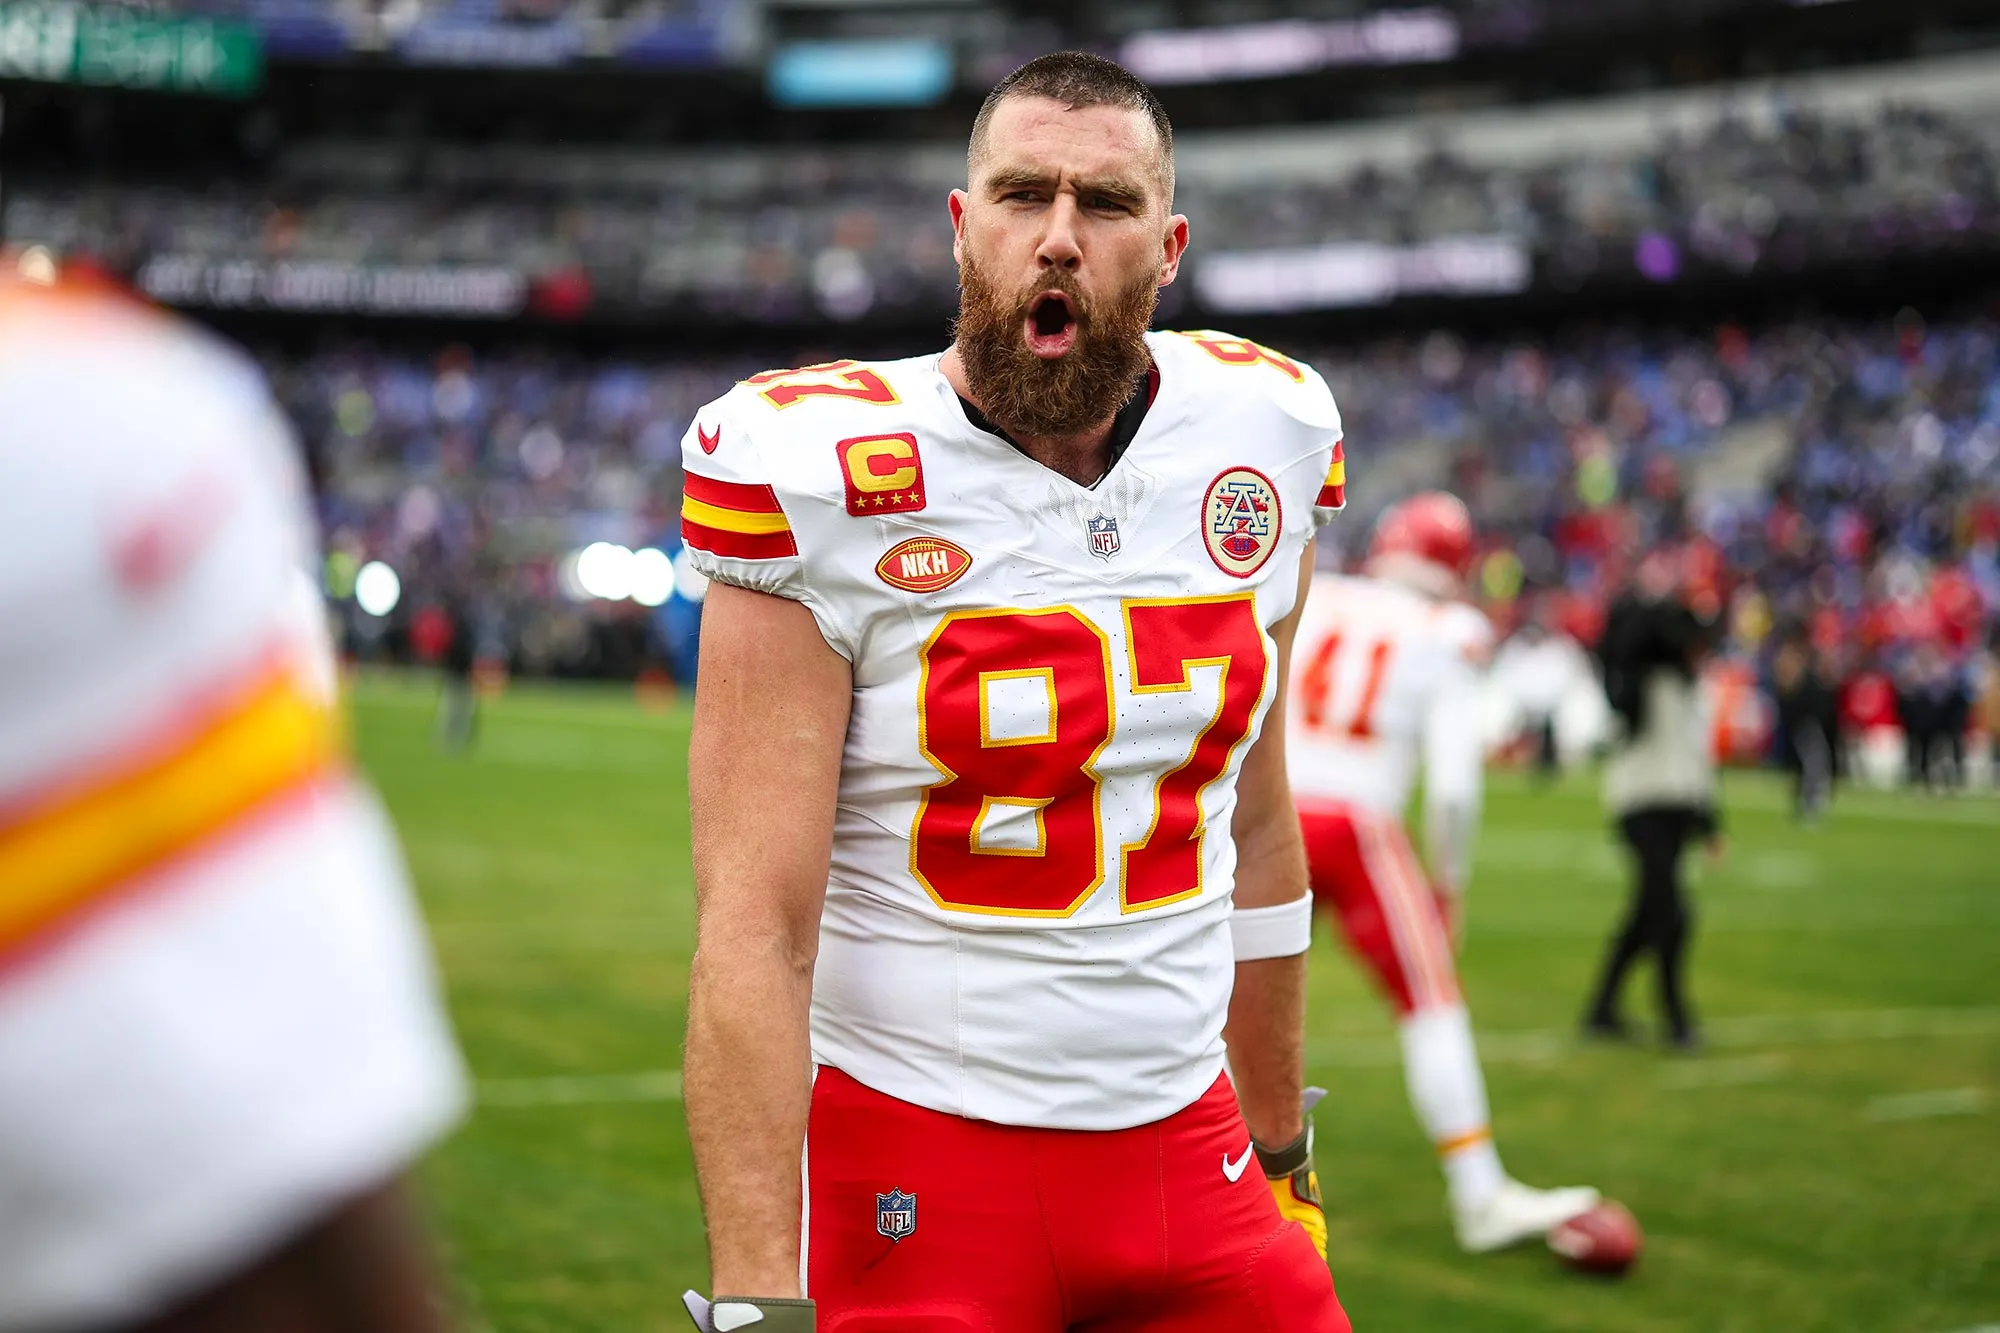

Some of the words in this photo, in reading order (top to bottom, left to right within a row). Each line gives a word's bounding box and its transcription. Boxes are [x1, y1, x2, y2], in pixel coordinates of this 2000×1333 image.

[846, 438, 917, 493] C
[1214, 482, 1268, 535] A
[900, 549, 950, 579] NKH
[1093, 532, 1118, 552] NFL
[1299, 629, 1391, 742] 41
[909, 591, 1270, 918] 87
[883, 1213, 910, 1231] NFL
